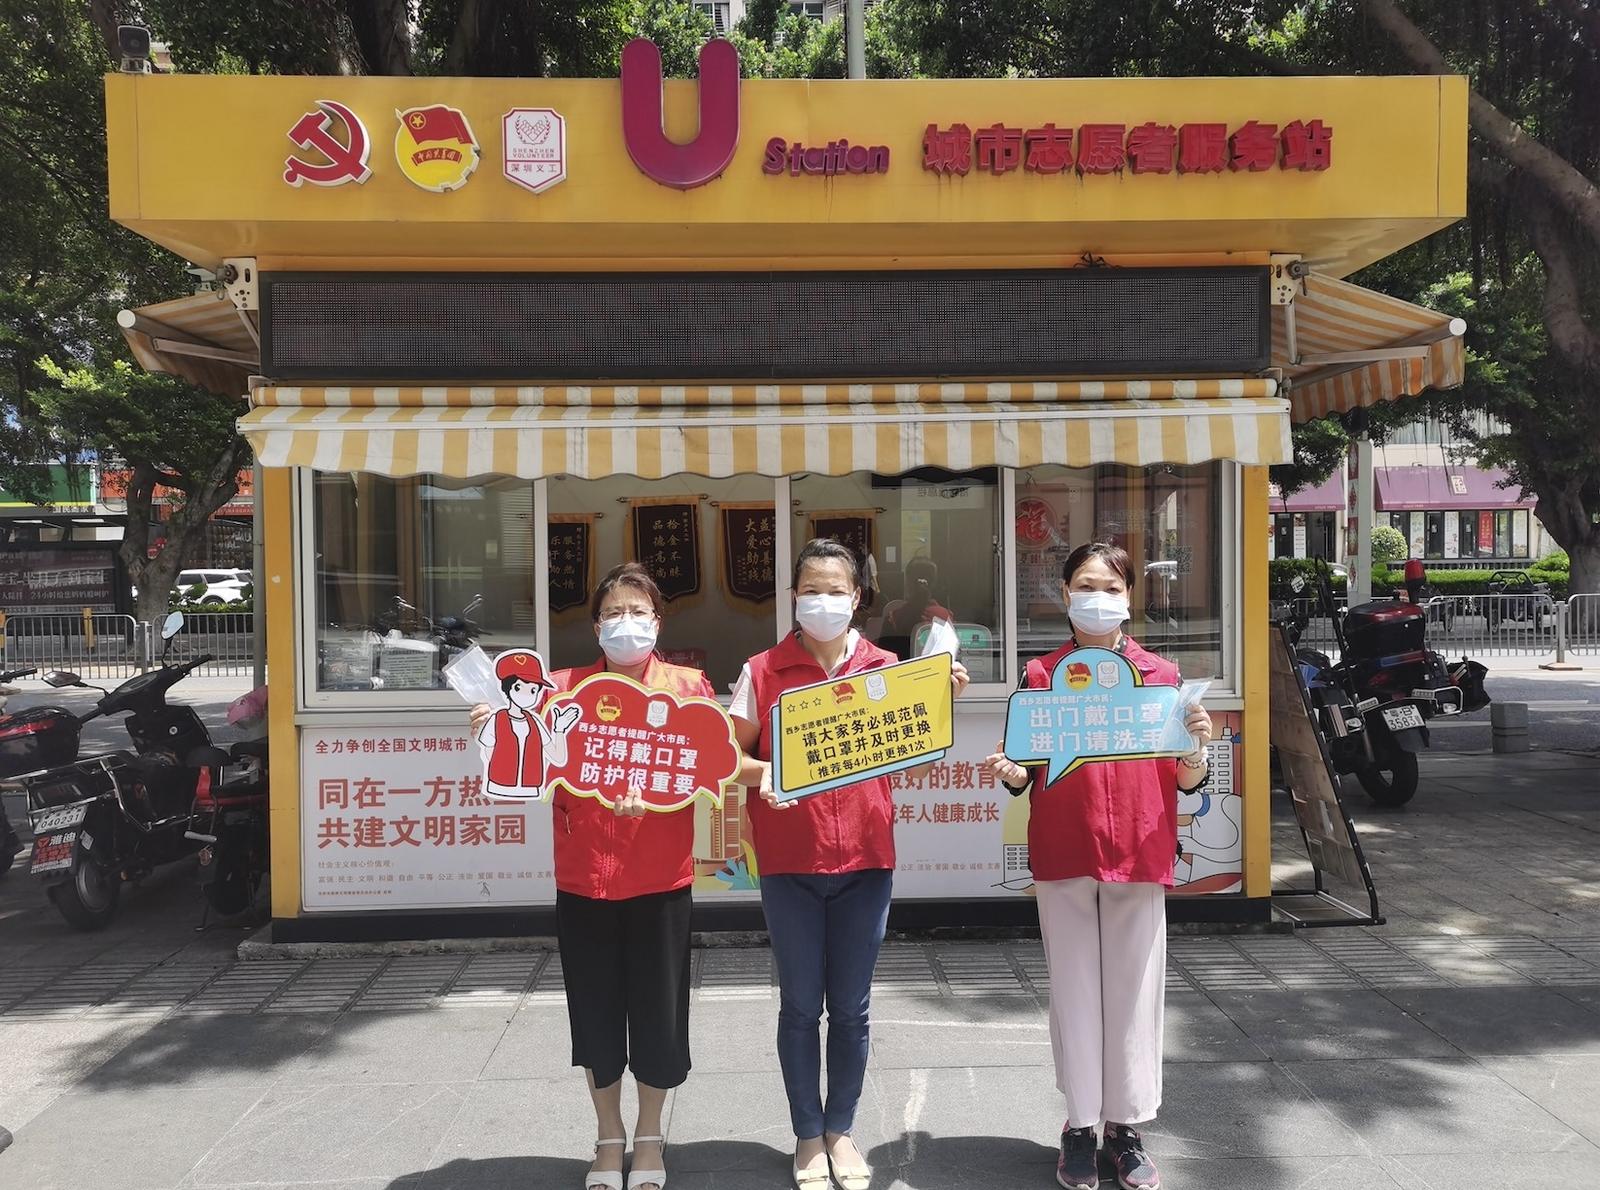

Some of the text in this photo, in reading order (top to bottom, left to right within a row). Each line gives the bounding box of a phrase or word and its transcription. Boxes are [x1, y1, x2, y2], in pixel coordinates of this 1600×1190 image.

[620, 38, 890, 191] U Station
[922, 119, 1333, 176] 城市志愿者服务站
[510, 163, 557, 173] 深圳义工
[562, 535, 576, 590] 服务热情
[653, 519, 667, 579] 品德高尚
[666, 518, 682, 578] 拾金不昧
[1018, 694, 1113, 706] 西乡志愿者提醒广大市民：
[1030, 702, 1164, 728] 出门戴口罩
[578, 721, 691, 746] 西乡志愿者提醒广大市民：
[785, 707, 870, 735] 西乡志愿者提醒广大市民：
[803, 702, 928, 747] 请大家务必规范佩
[315, 737, 468, 754] 全力争创全国文明城市
[584, 736, 698, 770] 记得戴口罩
[806, 720, 931, 766] 戴口罩并及时更换
[1031, 727, 1164, 753] 进门请洗手
[318, 775, 526, 810] 同在一方热
[580, 762, 696, 796] 防护很重要
[41, 814, 80, 828] 040231
[317, 814, 526, 849] 共建文明家园
